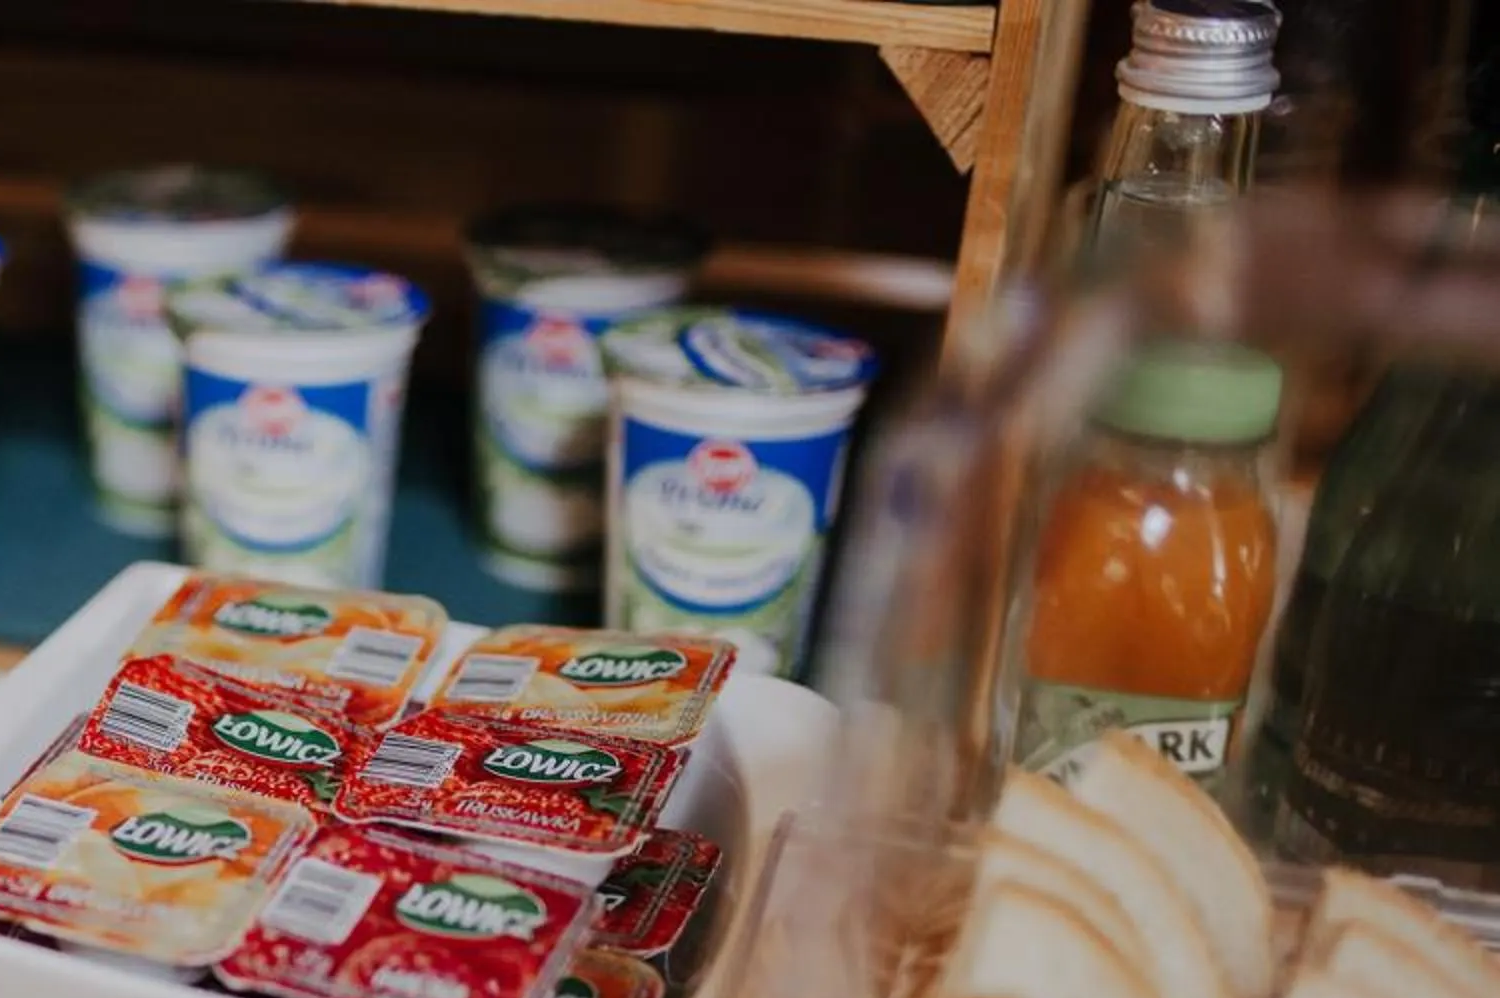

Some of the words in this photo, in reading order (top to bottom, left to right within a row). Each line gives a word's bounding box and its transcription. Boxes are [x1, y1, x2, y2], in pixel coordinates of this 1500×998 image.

[561, 656, 683, 679] ŁOWICZ
[215, 714, 342, 767] ŁOWICZ
[484, 749, 622, 782] ŁOWICZ
[113, 816, 246, 860] ŁOWICZ
[399, 882, 544, 940] ŁOWICZ
